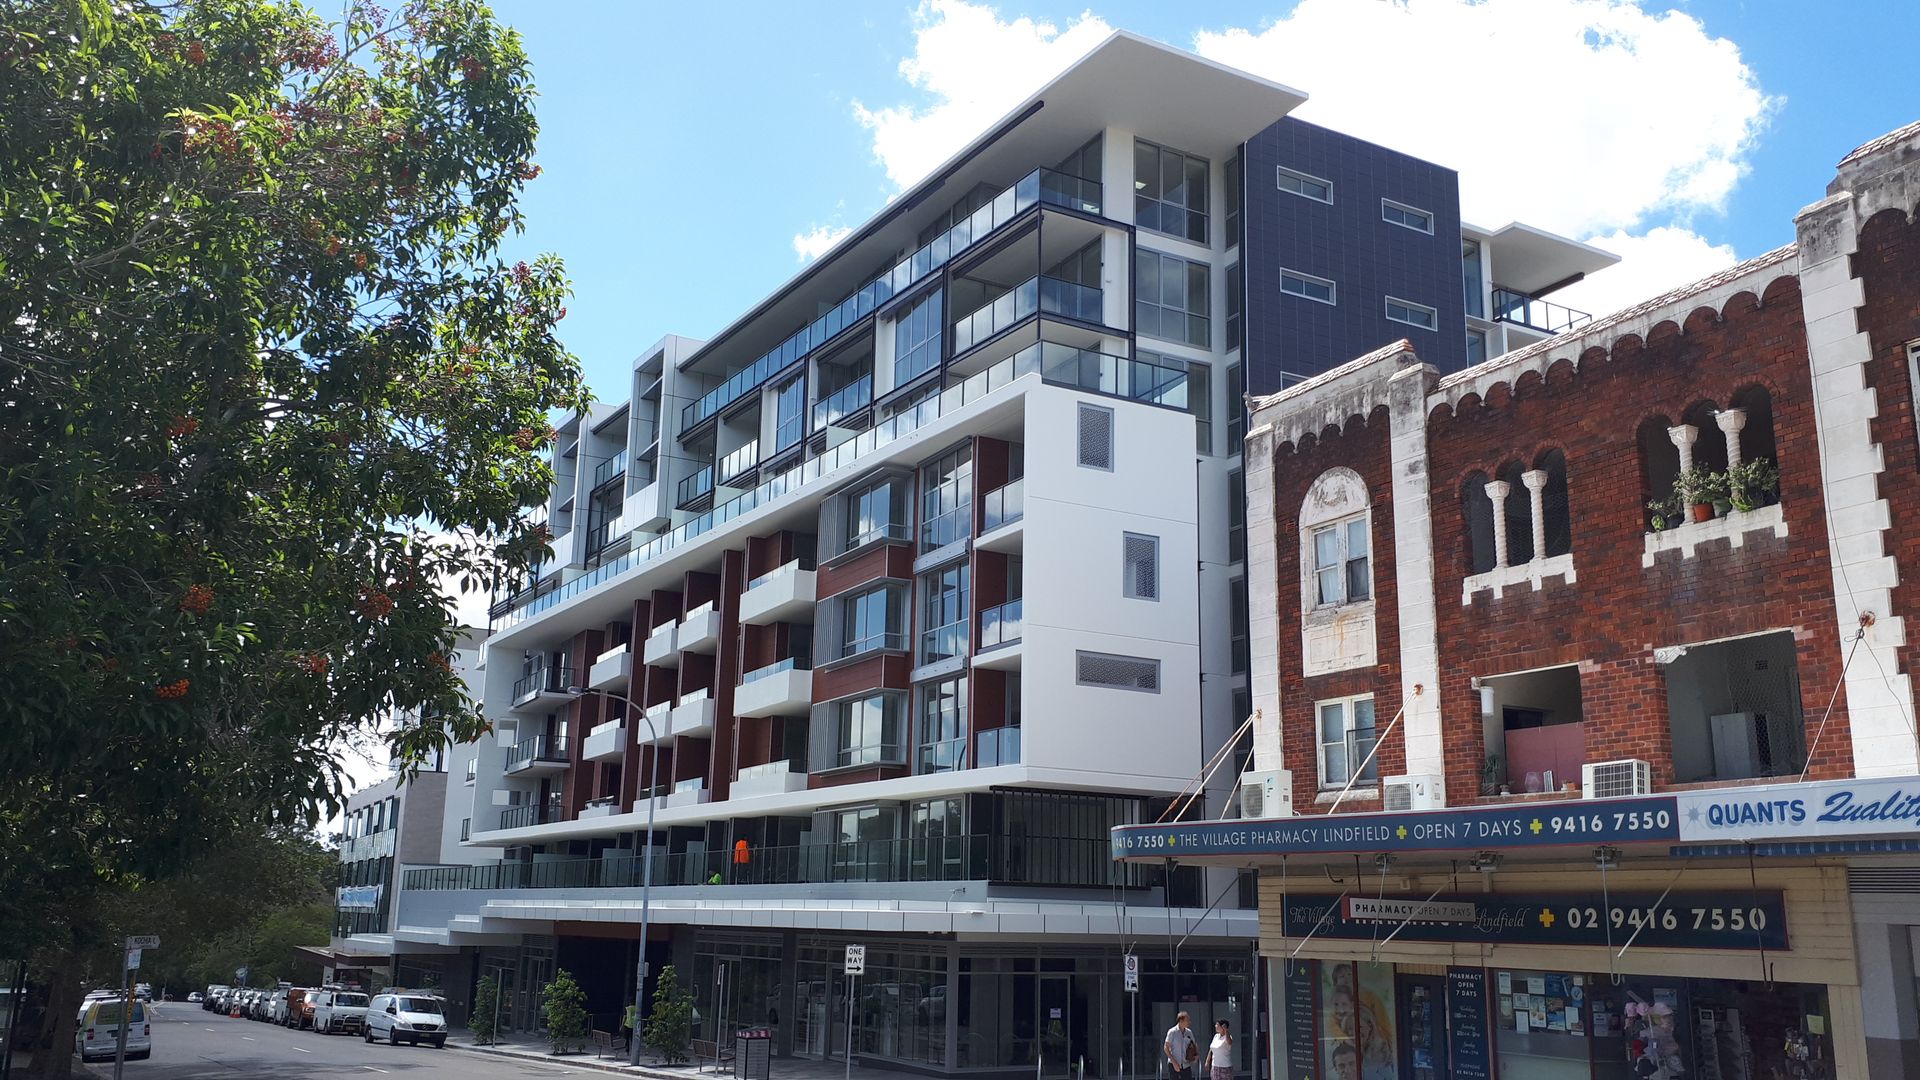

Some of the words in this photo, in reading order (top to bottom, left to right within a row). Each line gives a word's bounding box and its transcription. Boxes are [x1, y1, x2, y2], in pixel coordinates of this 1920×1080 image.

[1708, 800, 1806, 826] QUANTS
[1137, 834, 1164, 848] 7550
[1180, 833, 1198, 847] THE
[1202, 831, 1247, 846] VILLAGE
[1251, 828, 1318, 845] PHARMACY
[1323, 825, 1390, 842] LINDFIELD
[1413, 823, 1456, 840] OPEN
[1463, 822, 1472, 838] 7
[1479, 819, 1523, 838] DAYS
[1550, 815, 1604, 834] 9416
[1613, 810, 1670, 831] 7550
[1289, 906, 1306, 924] The
[1355, 903, 1413, 915] PHARMACY
[1417, 905, 1439, 915] OPEN
[1442, 906, 1448, 915] 7
[1451, 907, 1471, 917] DAYS
[1473, 907, 1531, 933] Lindfield
[1567, 908, 1598, 929] 02
[1610, 908, 1678, 930] 9416
[1691, 908, 1767, 931] 7550
[848, 947, 862, 955] ONE
[1449, 972, 1482, 980] PHARMACY
